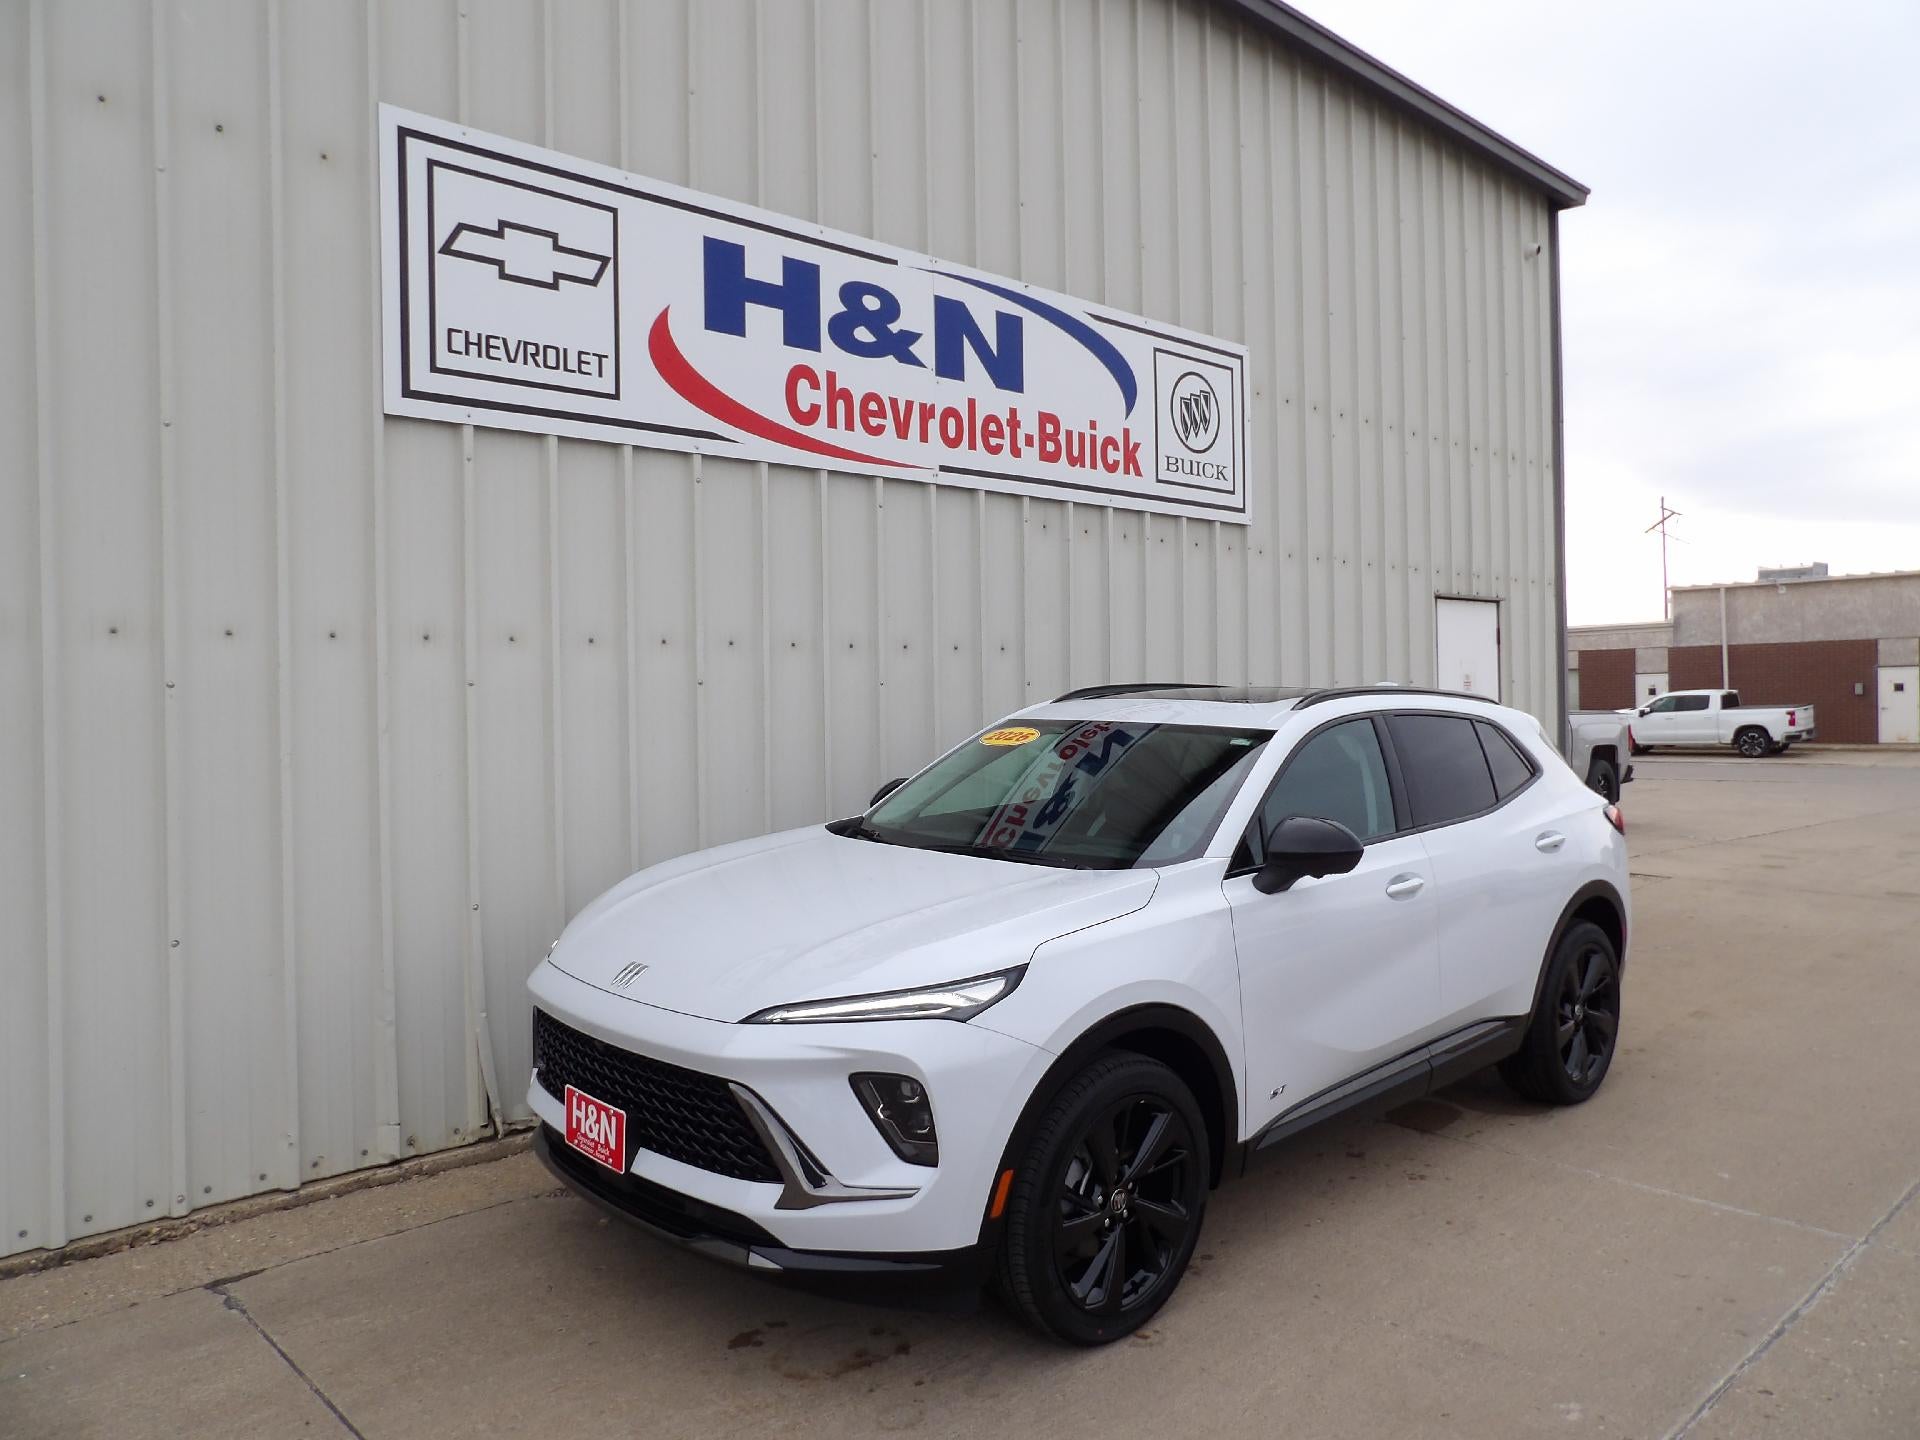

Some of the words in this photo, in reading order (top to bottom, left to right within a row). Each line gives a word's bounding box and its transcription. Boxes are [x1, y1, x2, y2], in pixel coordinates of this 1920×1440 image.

[703, 235, 1025, 394] H&N
[447, 327, 608, 378] CHEVROLET
[785, 363, 1144, 477] Chevrolet-Buick
[1165, 455, 1228, 482] BUICK
[983, 730, 1035, 742] 2026
[572, 1095, 616, 1150] H&N
